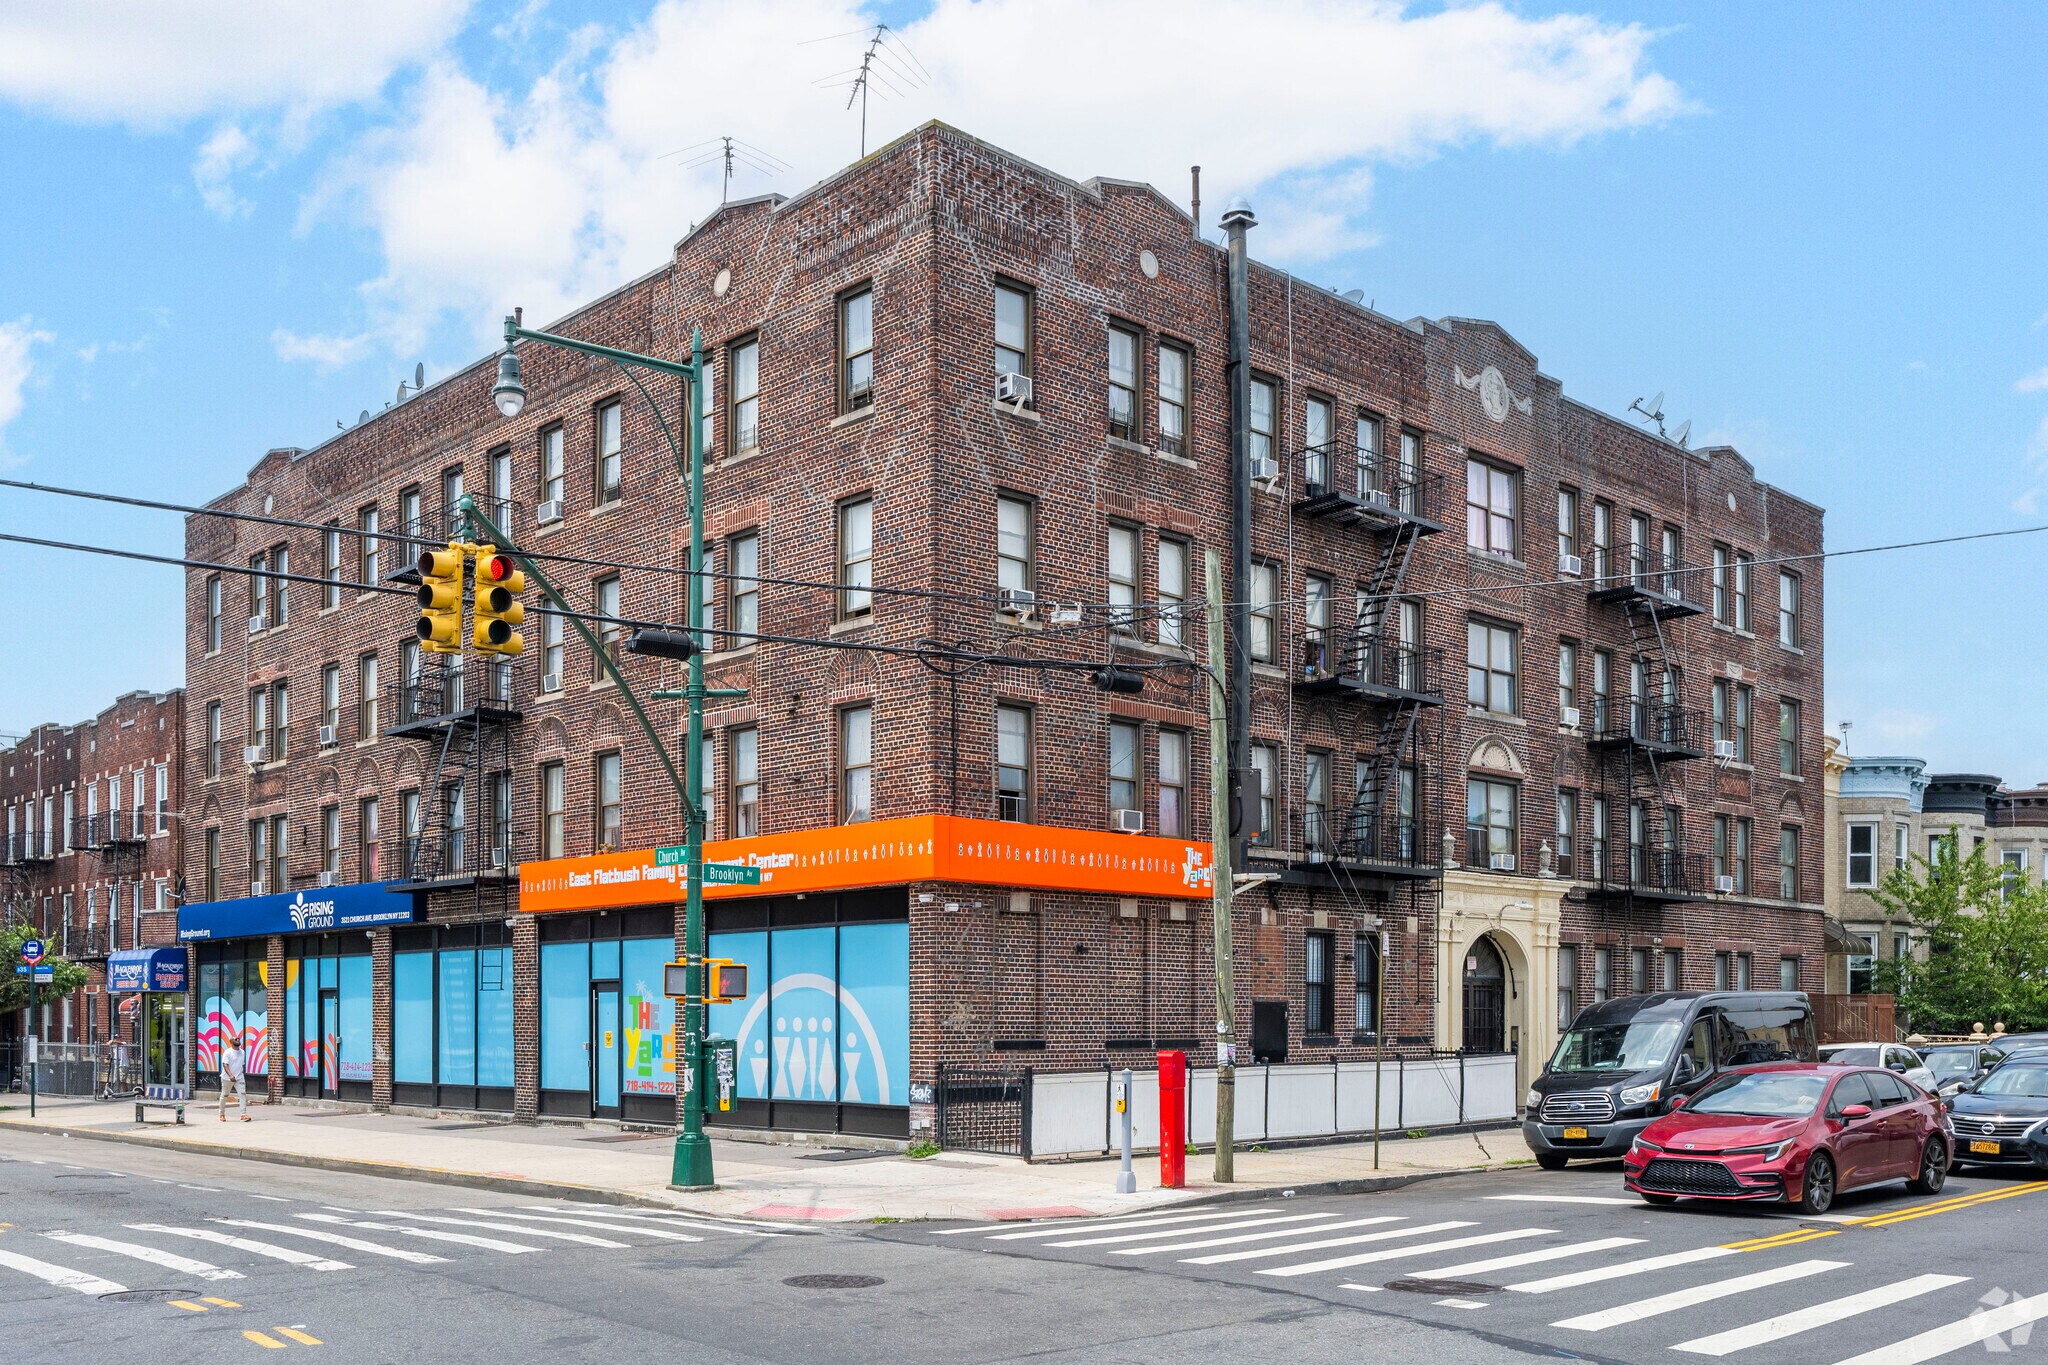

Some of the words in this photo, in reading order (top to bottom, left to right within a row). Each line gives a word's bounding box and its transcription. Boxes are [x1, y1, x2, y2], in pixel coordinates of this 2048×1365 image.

[658, 850, 679, 864] Church
[569, 871, 592, 888] East
[594, 866, 640, 885] Flatbush
[748, 852, 794, 869] Center
[709, 867, 744, 884] Brooklyn
[309, 900, 334, 916] RISING
[308, 916, 334, 928] GROUND
[350, 915, 365, 923] CHURCH
[628, 996, 660, 1030] THE
[626, 1080, 675, 1093] 718-414-1222
